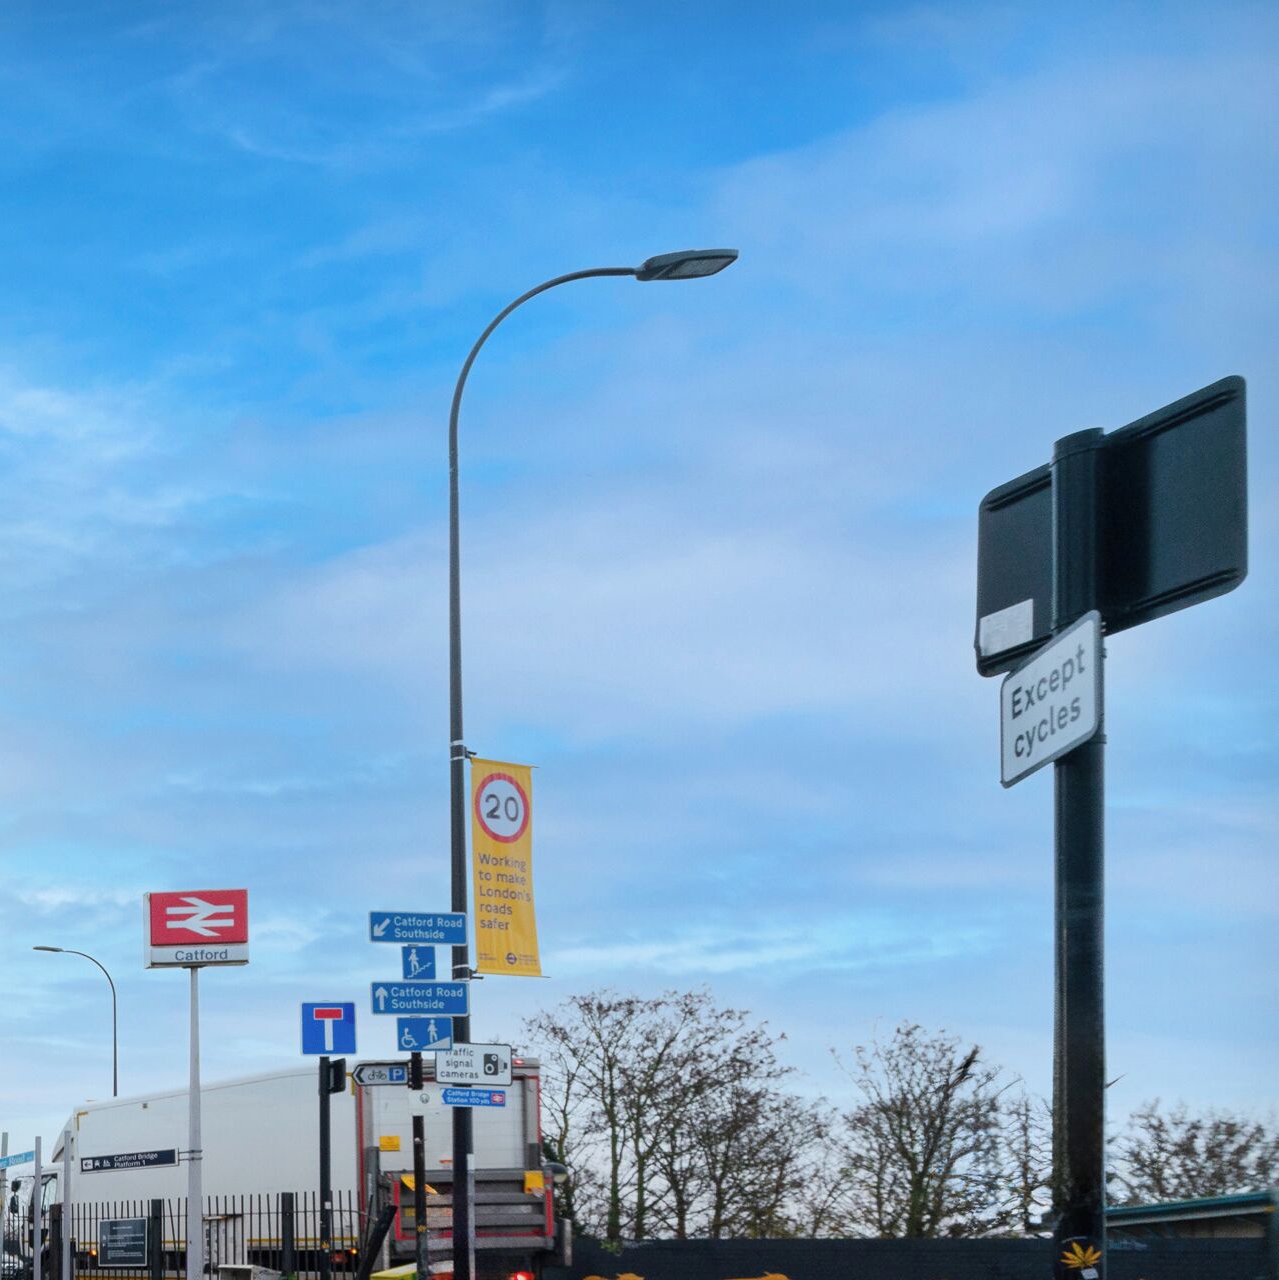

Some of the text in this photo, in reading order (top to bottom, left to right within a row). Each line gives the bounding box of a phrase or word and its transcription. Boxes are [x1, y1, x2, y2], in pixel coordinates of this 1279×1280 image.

[1011, 643, 1085, 720] Except
[1013, 695, 1081, 758] cycles
[485, 794, 519, 822] 20
[478, 852, 526, 872] Working
[479, 870, 526, 885] to make
[479, 887, 531, 902] London's
[480, 902, 513, 915] roads
[394, 916, 463, 928] Catford Road
[480, 918, 509, 930] safer
[394, 928, 445, 939] Southside
[175, 949, 228, 961] Catford
[391, 986, 463, 997] Catford Road
[391, 999, 445, 1009] Southside
[446, 1060, 473, 1069] signal
[441, 1070, 479, 1079] cameras
[114, 1152, 158, 1162] Catford Bridge
